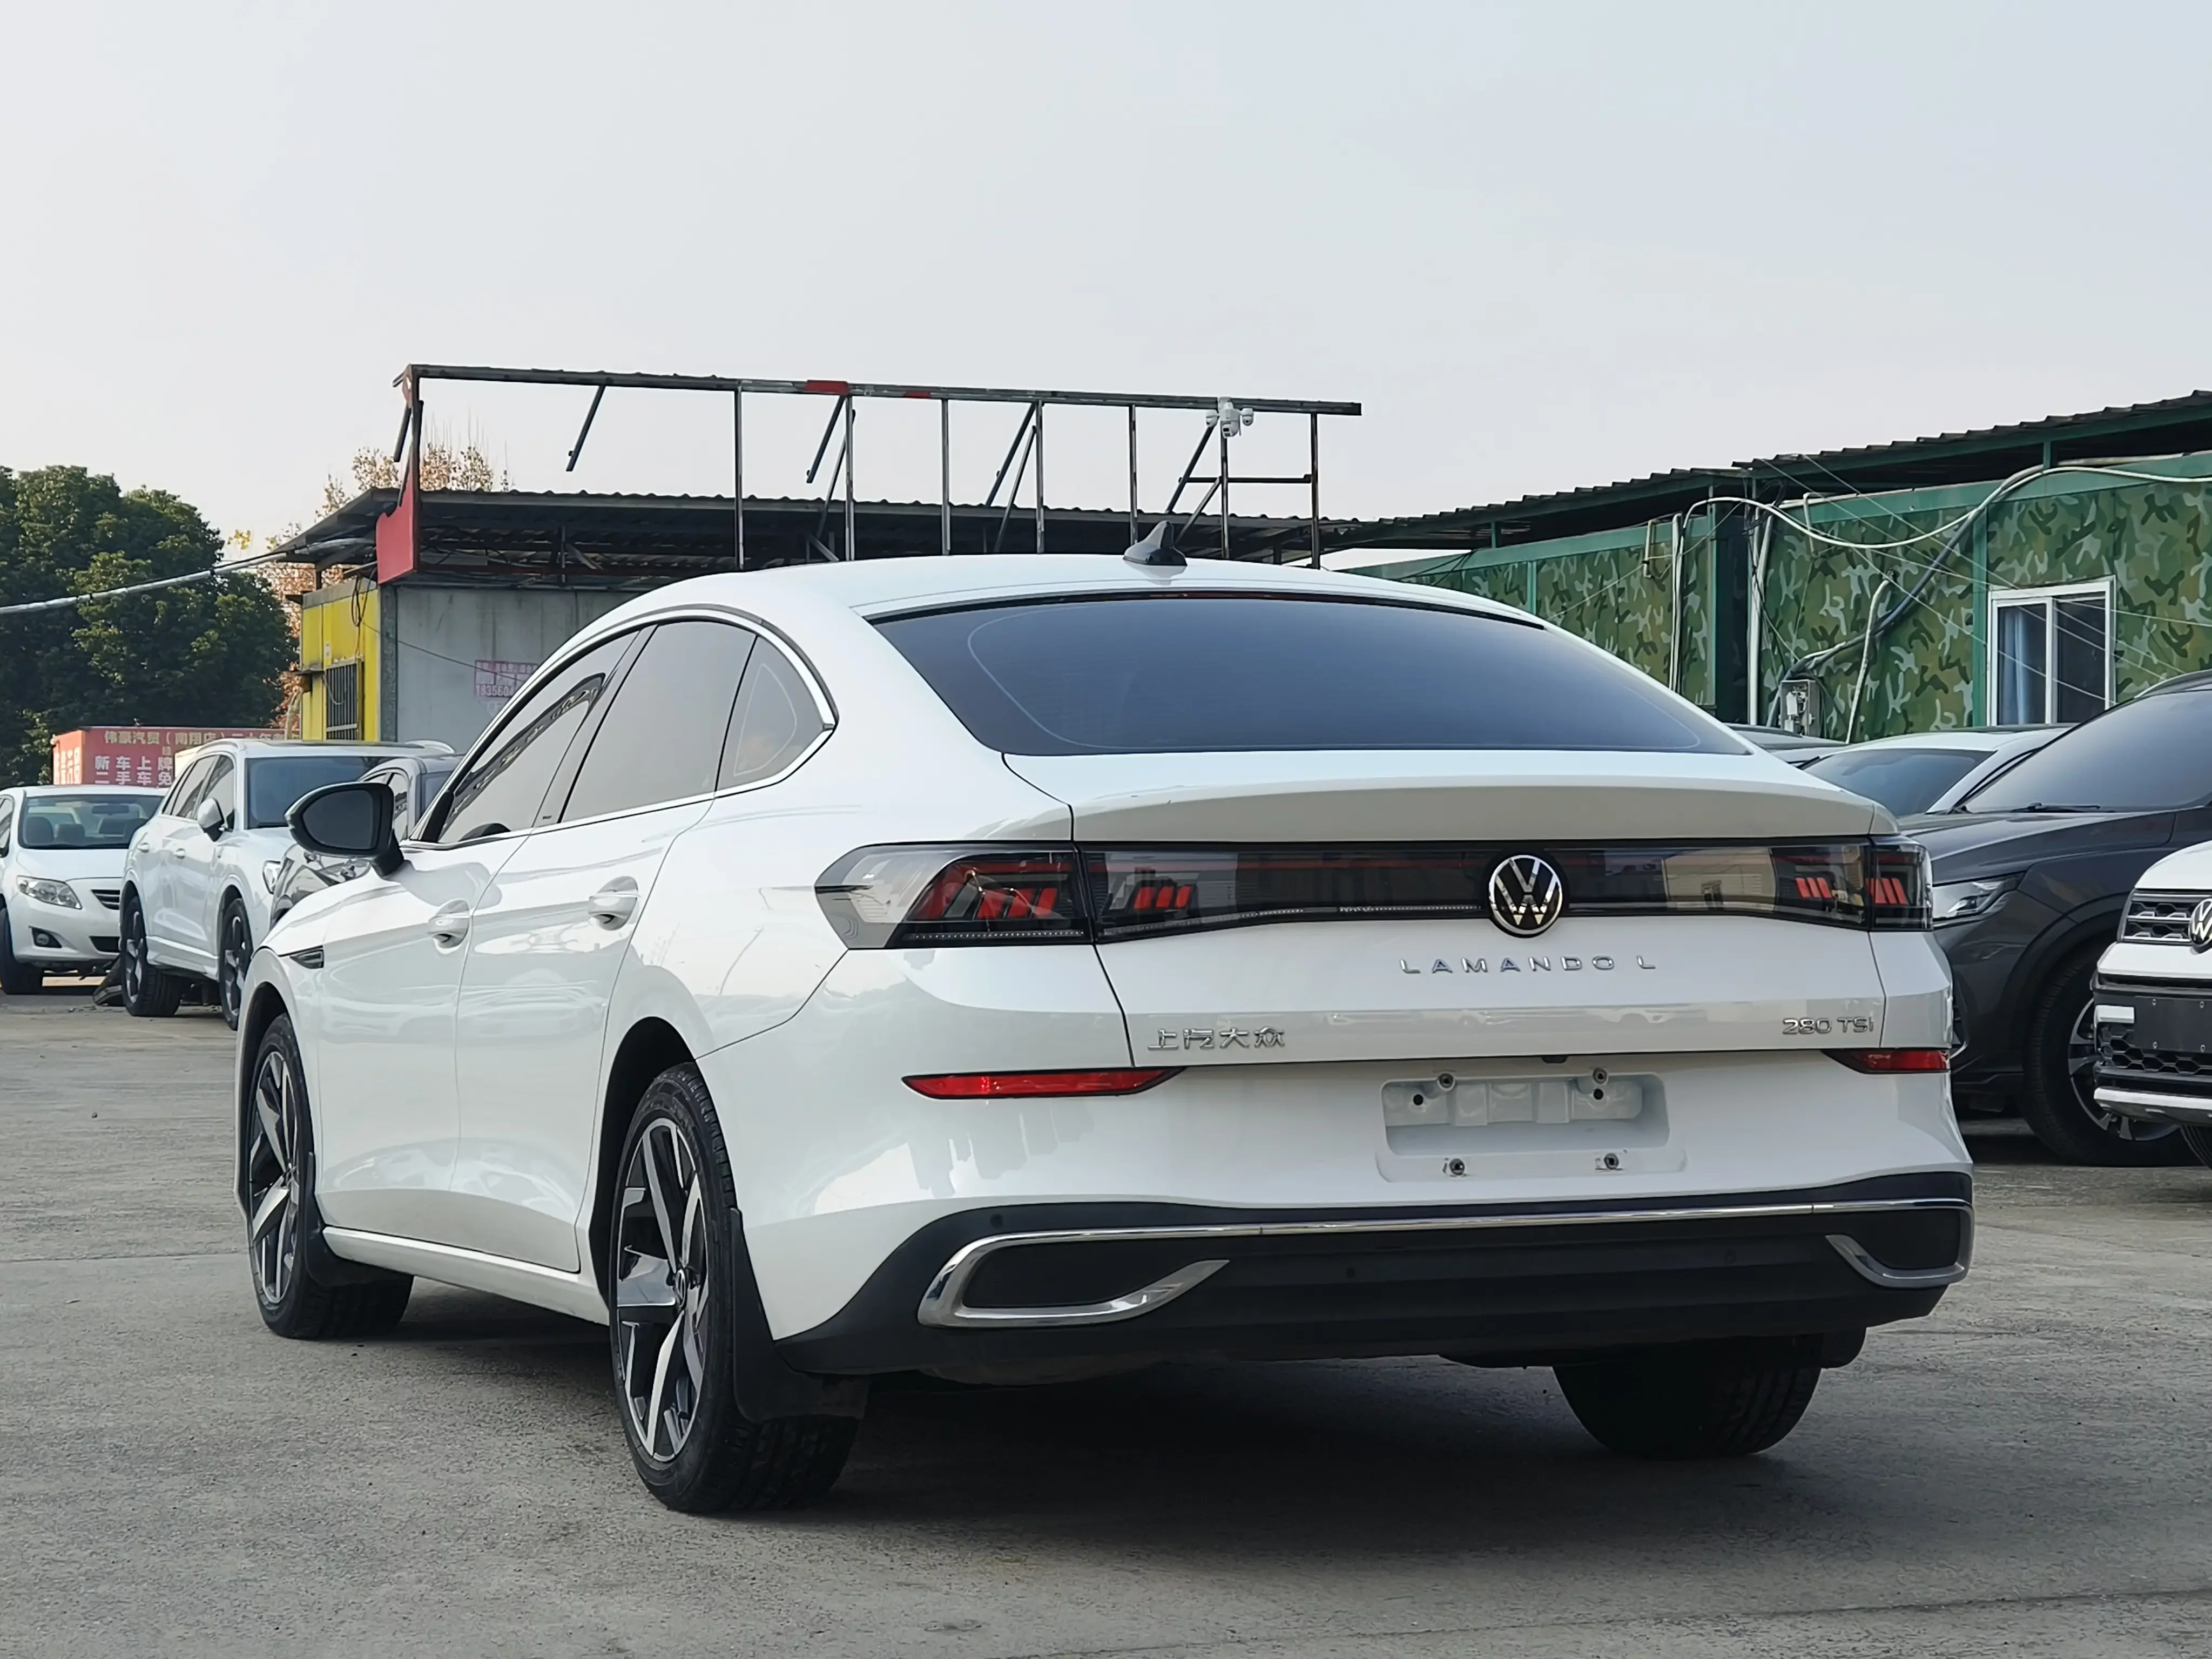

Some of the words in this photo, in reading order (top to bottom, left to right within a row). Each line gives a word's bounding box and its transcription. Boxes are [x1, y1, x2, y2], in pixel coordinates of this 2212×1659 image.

[95, 756, 173, 771] 新车上牌
[95, 771, 172, 786] 二手车免
[1400, 955, 1615, 973] LAMANDO
[1636, 955, 1656, 970] L
[1782, 1017, 1832, 1035] 280
[1147, 1026, 1285, 1050] 上汽大众
